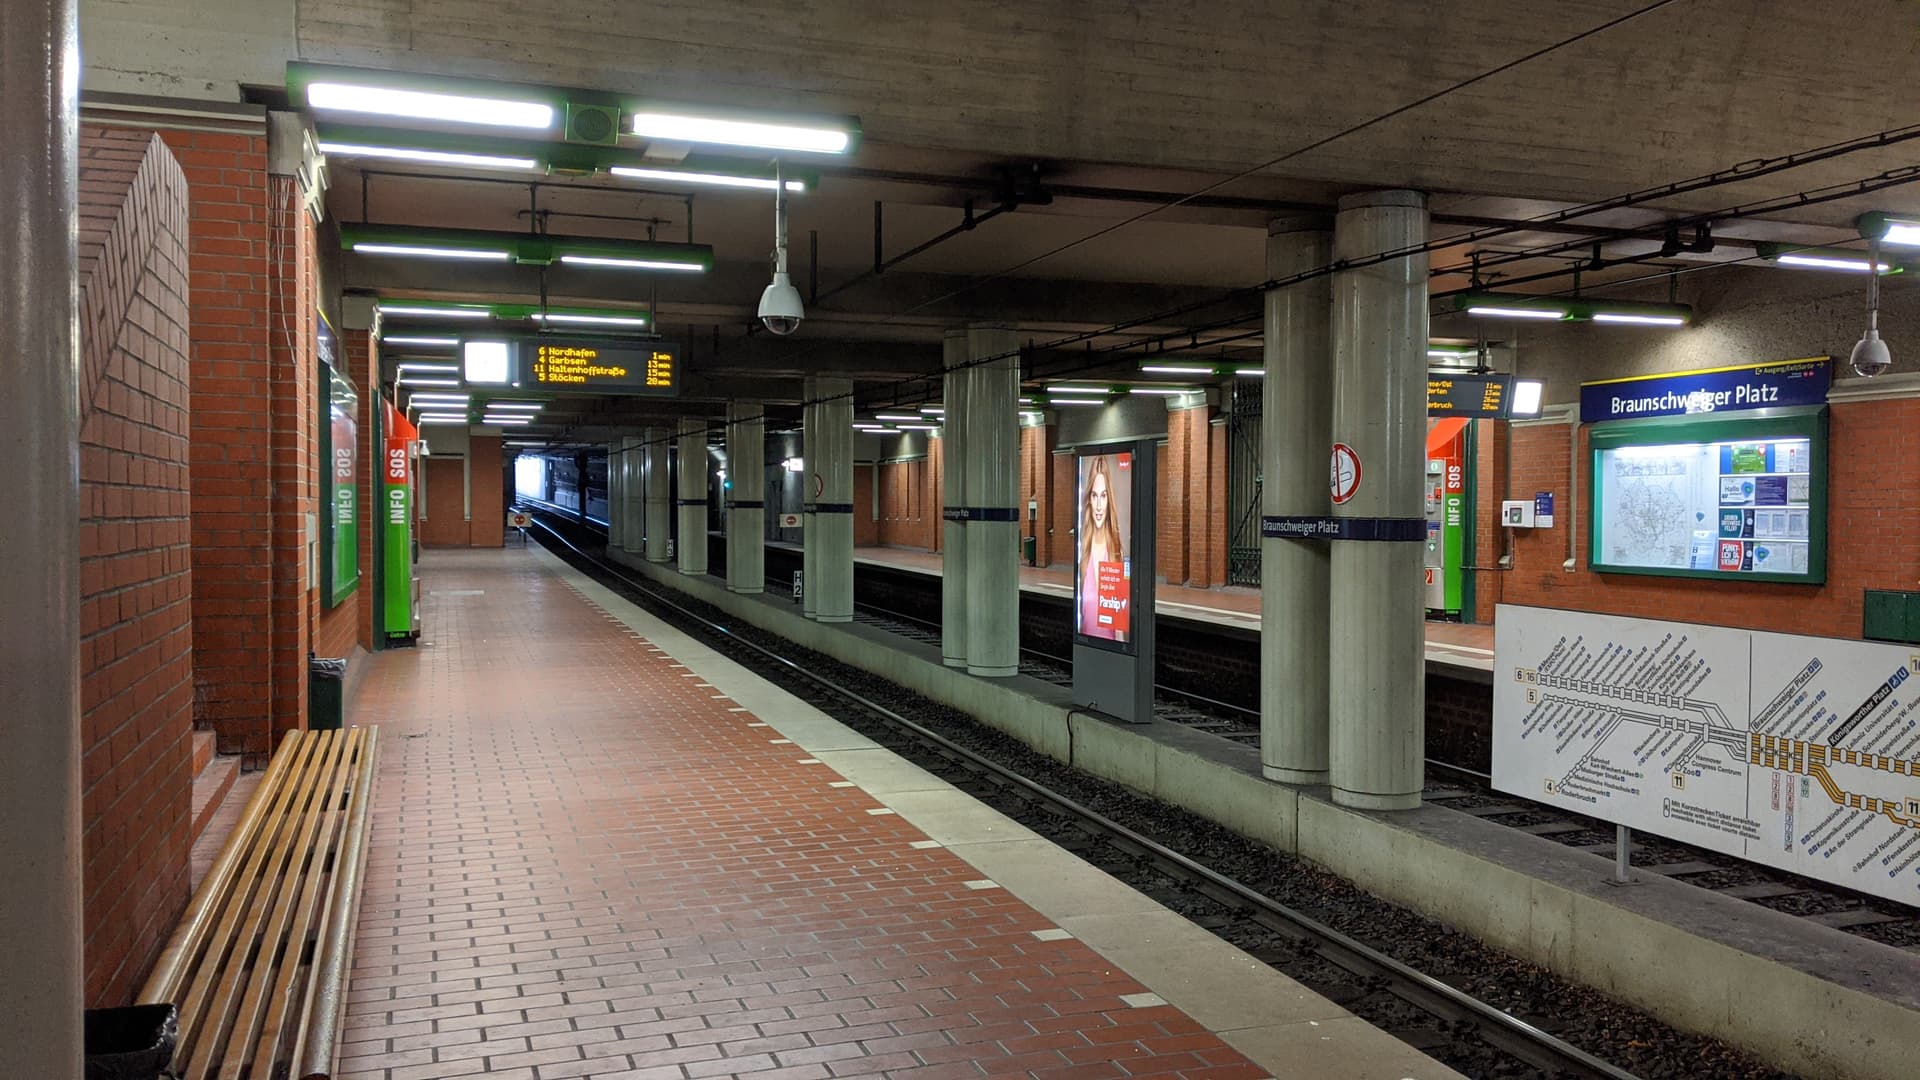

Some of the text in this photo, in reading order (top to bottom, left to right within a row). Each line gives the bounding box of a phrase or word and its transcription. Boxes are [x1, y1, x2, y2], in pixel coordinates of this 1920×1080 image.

[539, 346, 545, 355] 6
[549, 347, 596, 358] Nordhafen
[549, 356, 587, 365] Garbsen
[533, 364, 545, 373] 11
[549, 365, 626, 376] Haltenhoffstraße
[538, 373, 545, 382] 5
[549, 373, 585, 382] Stöcken
[1611, 383, 1779, 413] Braunschweiger Platz
[390, 448, 405, 478] SOS
[1448, 465, 1461, 488] SOS
[390, 489, 405, 524] INFO
[1448, 498, 1460, 526] INFO
[1263, 519, 1339, 536] Braunschweiger Platz
[794, 572, 802, 596] H 2
[1099, 595, 1120, 613] Parship
[1516, 670, 1535, 682] 6 16
[1529, 691, 1535, 701] 5
[1752, 671, 1810, 730] Braunschweiger Platz
[1829, 700, 1875, 746] Königsworther
[1872, 685, 1892, 705] Platz
[1863, 704, 1894, 734] Universität
[1878, 726, 1911, 756] Appelstraße
[1682, 766, 1695, 776] Zoo
[1546, 782, 1552, 792] 4
[1673, 775, 1683, 787] 11
[1908, 801, 1919, 815] 11
[1855, 826, 1906, 870] Bahnhof Nordstadt
